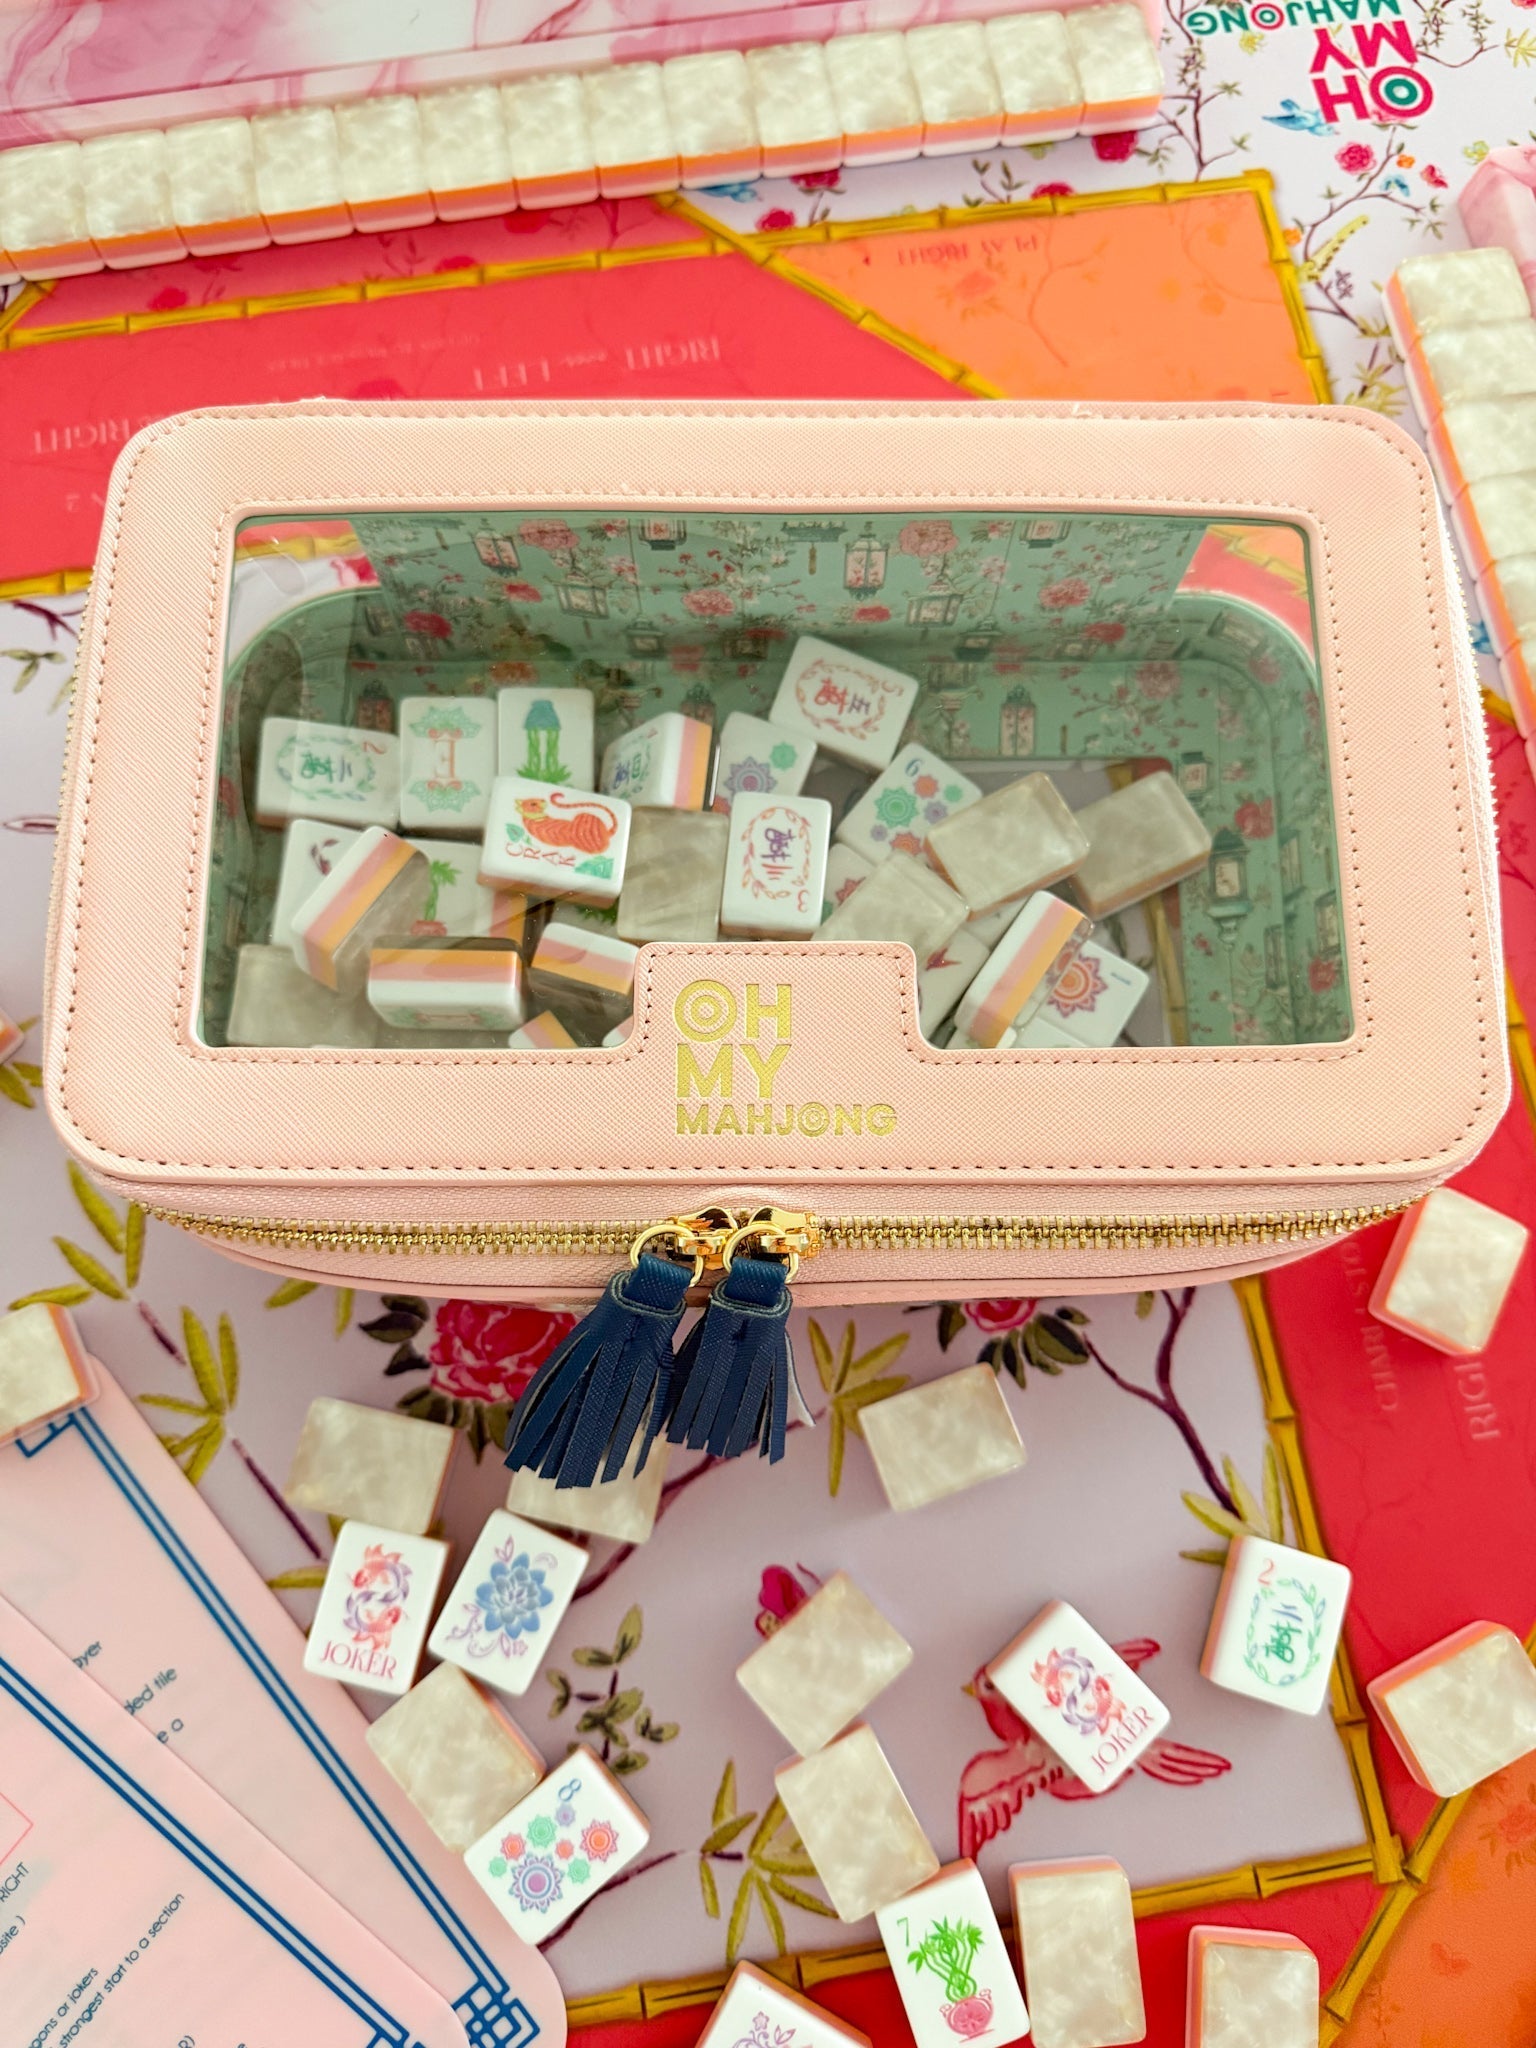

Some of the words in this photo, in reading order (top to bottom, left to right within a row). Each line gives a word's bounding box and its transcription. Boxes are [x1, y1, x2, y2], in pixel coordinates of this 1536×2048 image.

[1187, 0, 1402, 35] MAHJONG
[1309, 20, 1418, 74] MY
[1311, 66, 1434, 124] OH
[625, 335, 720, 371] RIGHT
[33, 418, 131, 454] RIGHT
[505, 842, 576, 867] CRAK
[673, 979, 792, 1043] OH
[676, 1043, 792, 1099] MY
[676, 1102, 898, 1138] MAHJONG
[1257, 1557, 1275, 1587] 2
[319, 1639, 399, 1681] JOKER
[153, 1668, 178, 1691] tile
[1090, 1705, 1155, 1774] JOKER
[557, 1777, 582, 1802] 8
[896, 1917, 910, 1948] 7
[59, 1991, 105, 2048] strongest
[103, 1963, 128, 1994] start
[124, 1949, 140, 1966] to
[138, 1937, 151, 1950] a
[148, 1892, 186, 1938] section
[57, 2002, 71, 2018] or
[67, 1967, 99, 2005] jokers
